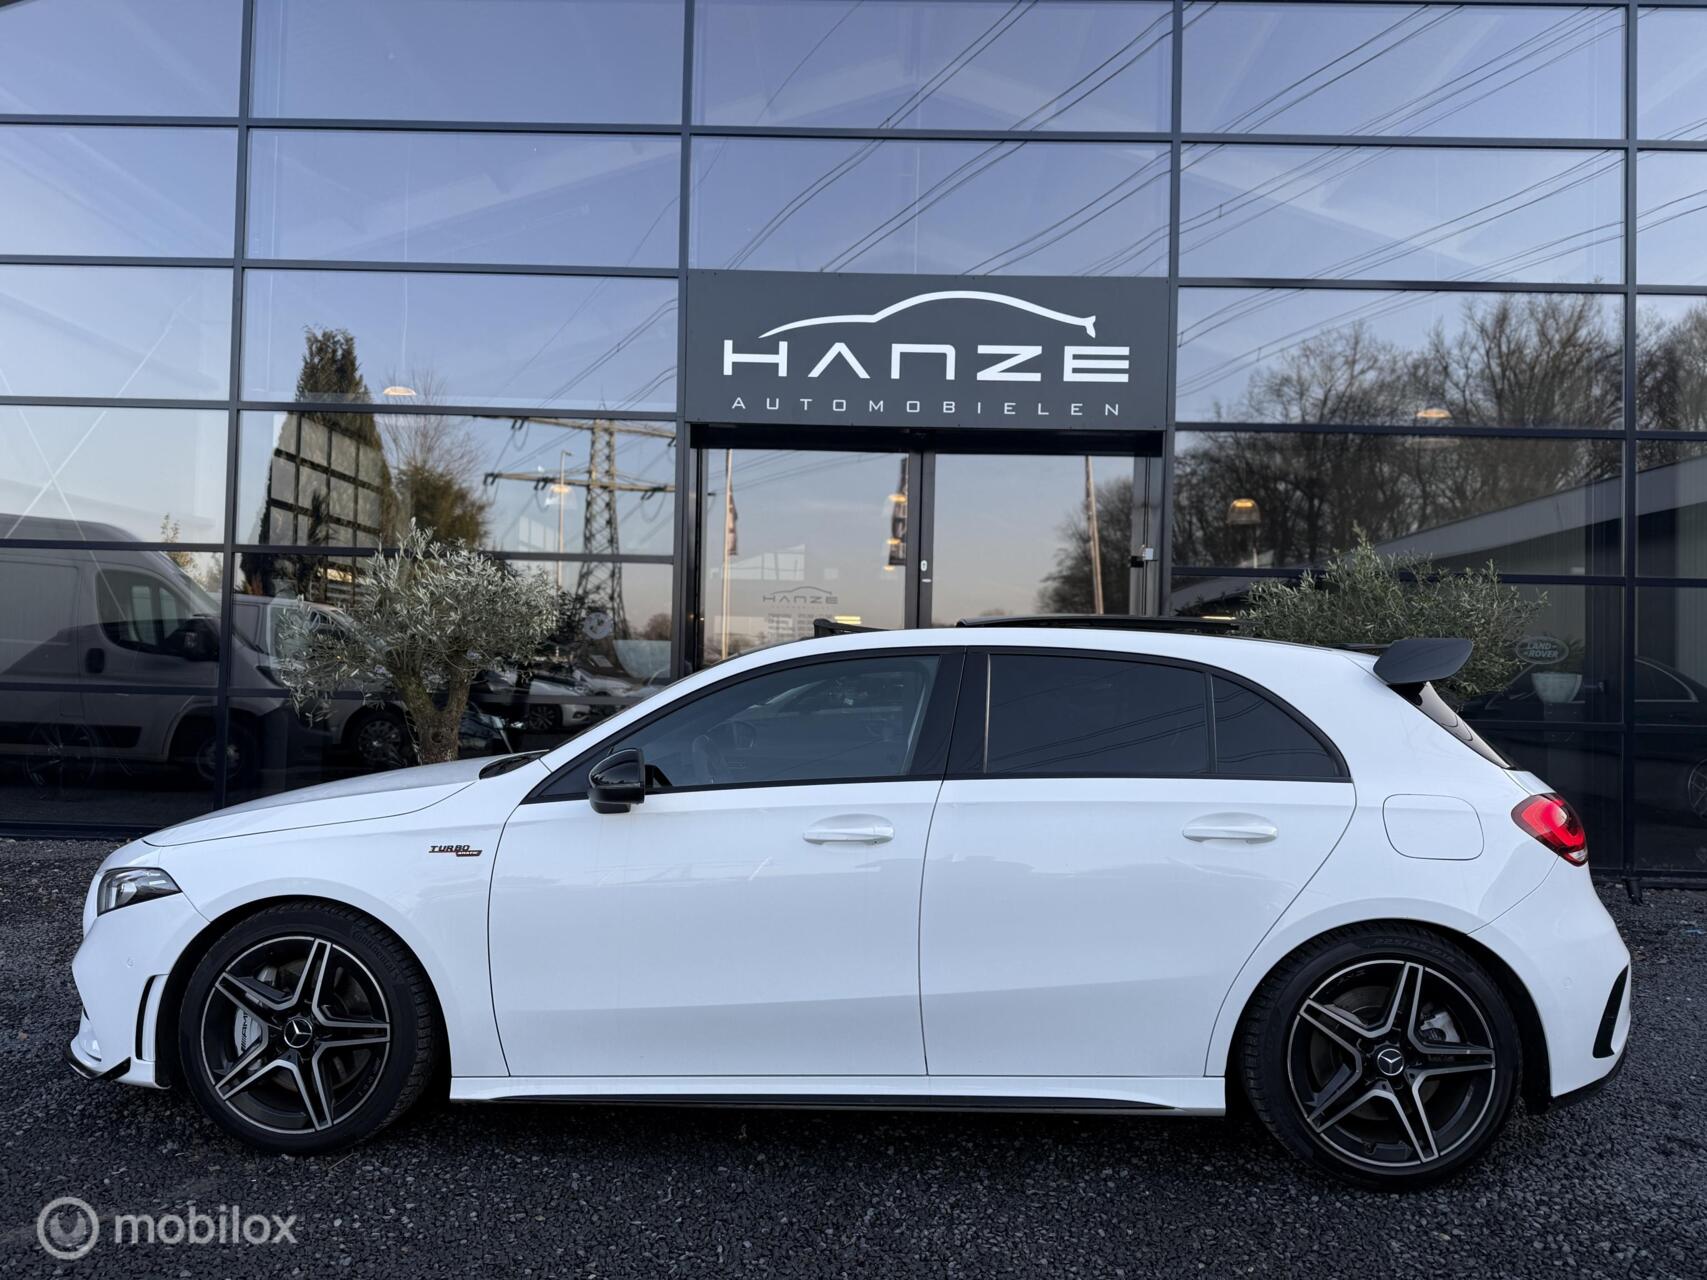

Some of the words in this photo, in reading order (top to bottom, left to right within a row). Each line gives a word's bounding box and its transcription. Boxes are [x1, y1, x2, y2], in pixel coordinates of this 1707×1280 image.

[723, 339, 1130, 383] HANZE
[731, 397, 1120, 416] AUTOMOBIELEN
[762, 595, 839, 604] HANZE
[1527, 642, 1552, 650] LAND
[1528, 649, 1560, 658] ROVER
[429, 844, 471, 852] TURBO
